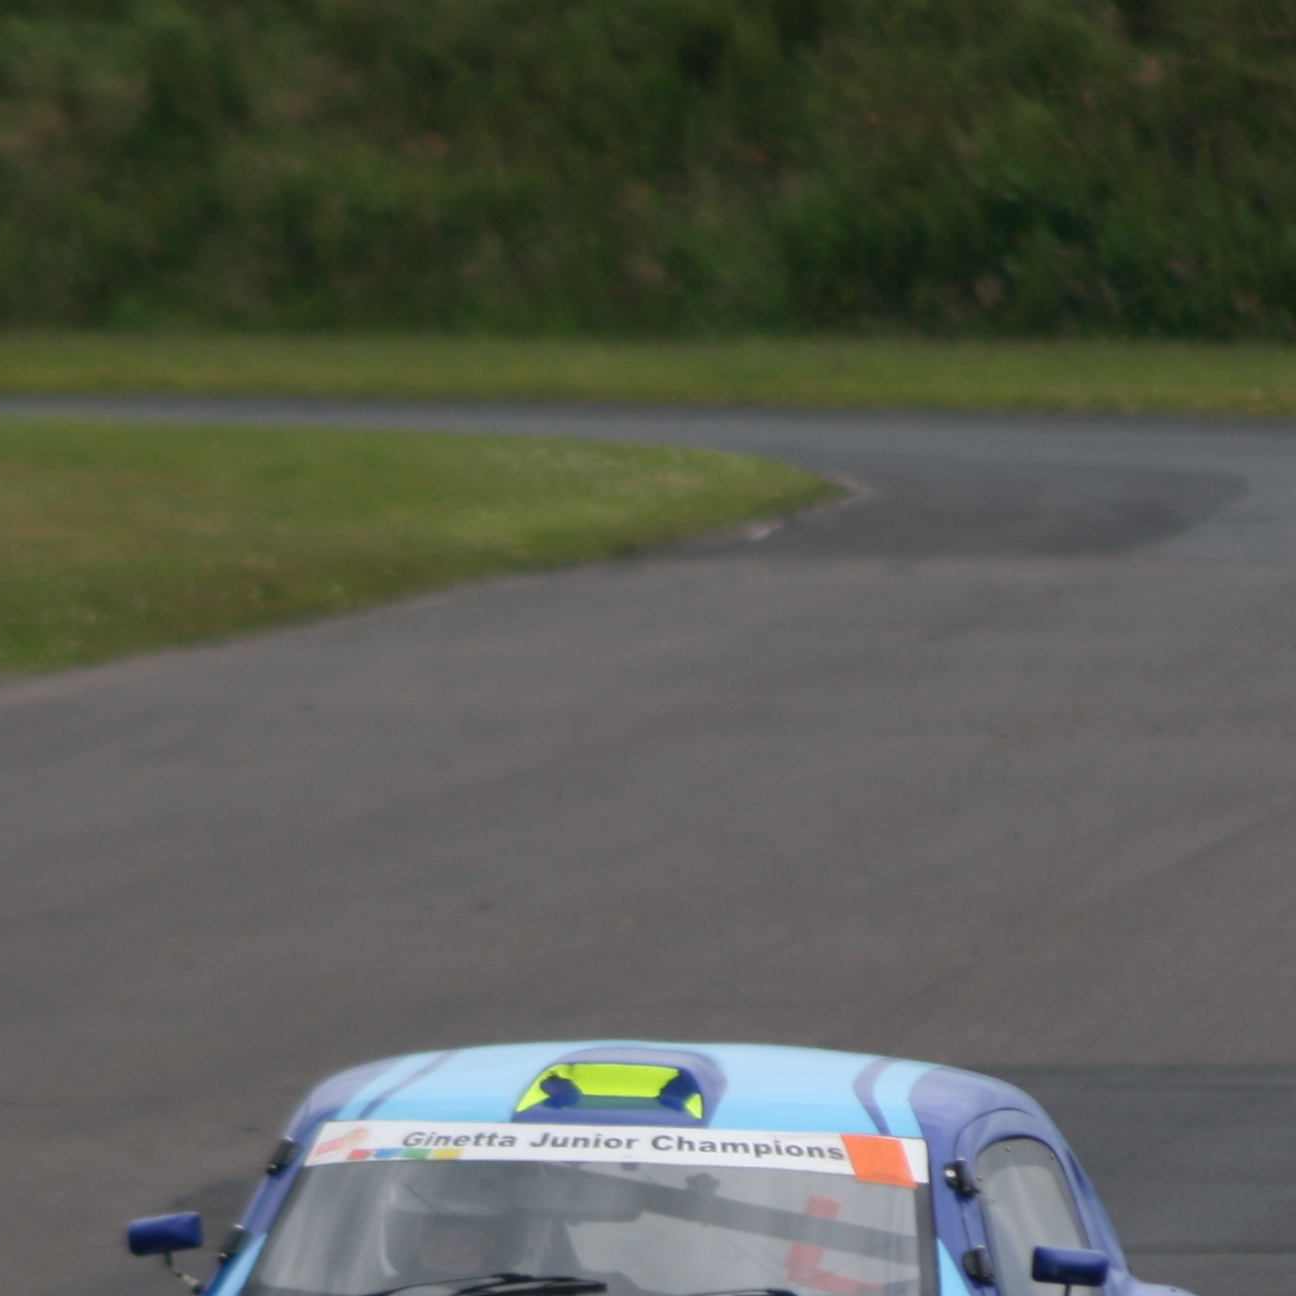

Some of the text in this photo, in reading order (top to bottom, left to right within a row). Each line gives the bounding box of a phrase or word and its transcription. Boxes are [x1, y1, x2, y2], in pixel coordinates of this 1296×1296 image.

[402, 1131, 845, 1161] Ginetta Junior Champions
